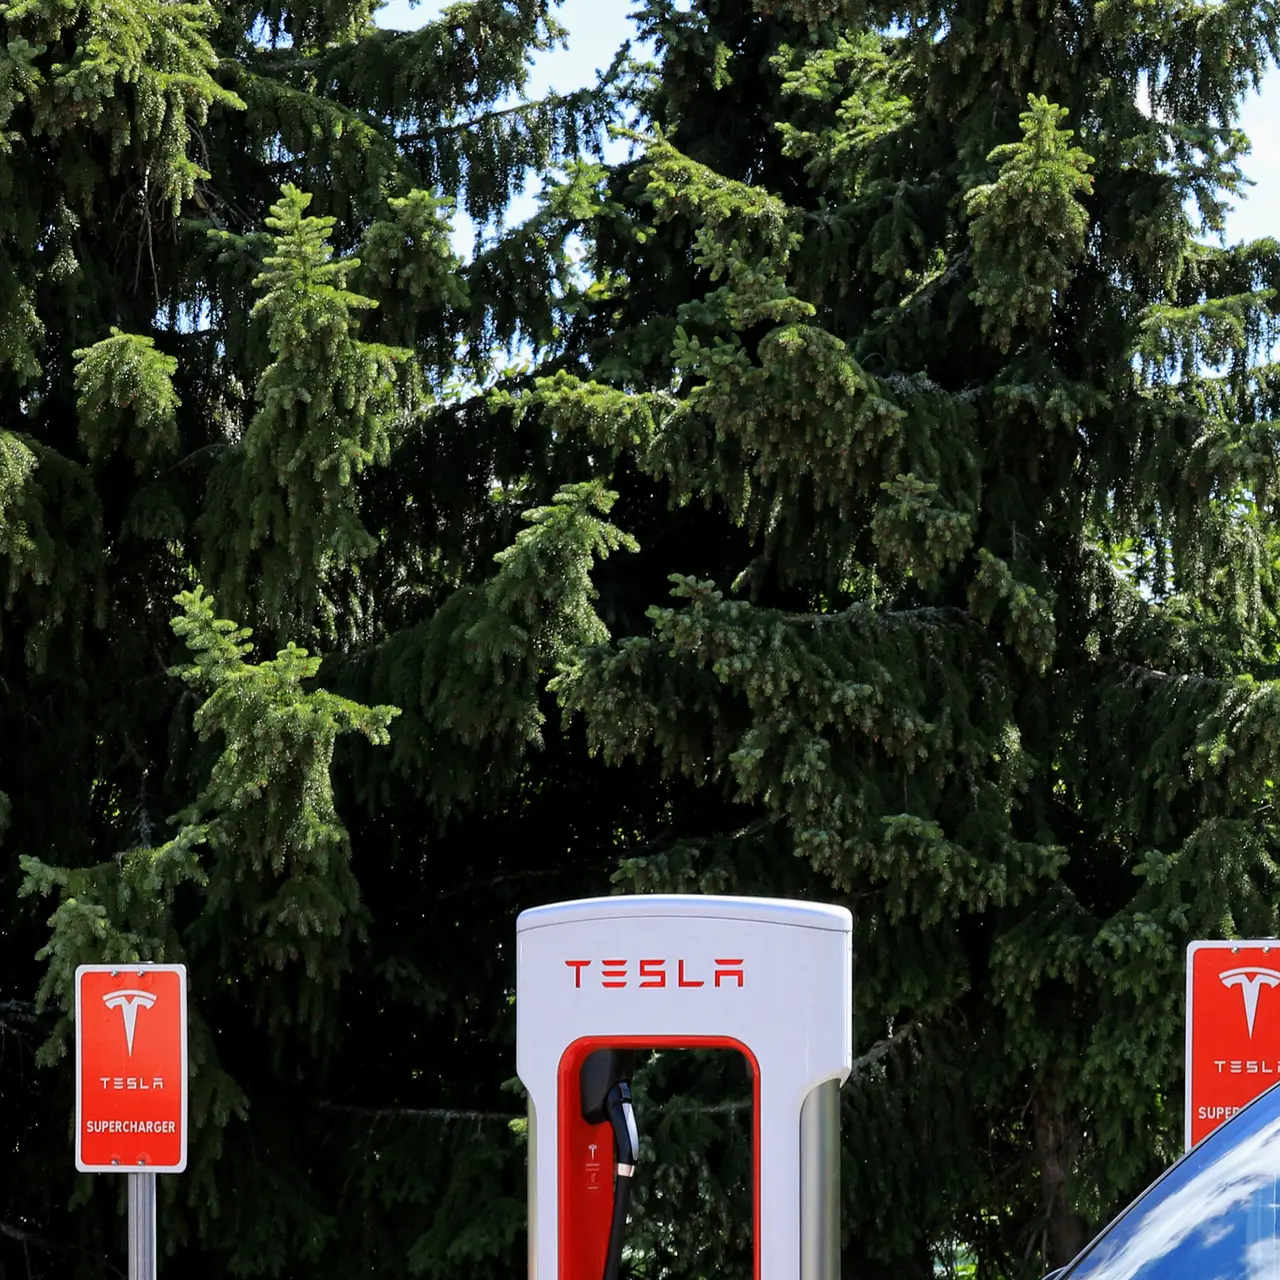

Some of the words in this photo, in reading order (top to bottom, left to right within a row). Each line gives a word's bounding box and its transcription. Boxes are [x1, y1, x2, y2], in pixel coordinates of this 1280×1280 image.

[564, 958, 744, 988] TESLA
[100, 1077, 164, 1090] TESLA
[86, 1120, 176, 1134] SUPERCHARGER
